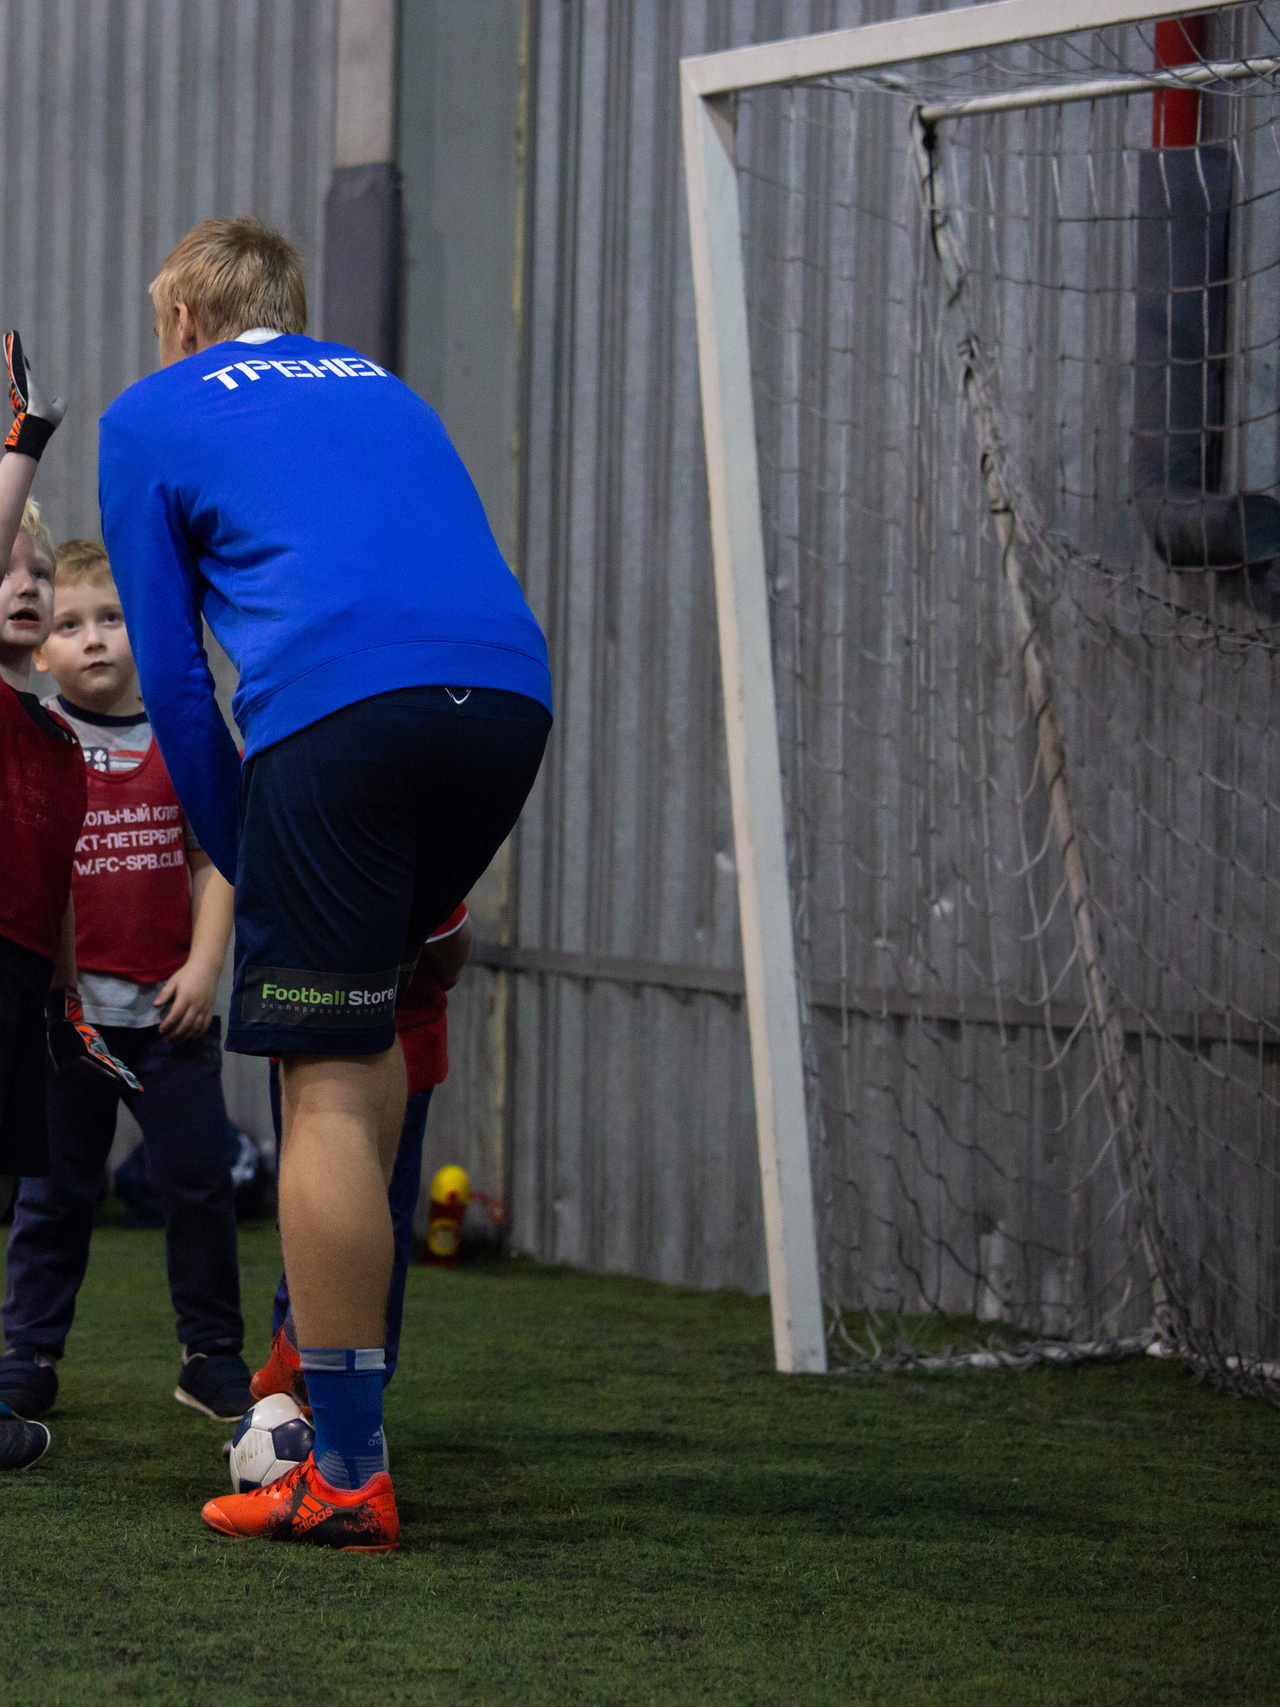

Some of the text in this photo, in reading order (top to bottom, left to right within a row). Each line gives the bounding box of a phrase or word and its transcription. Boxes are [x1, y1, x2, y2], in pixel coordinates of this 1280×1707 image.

[82, 803, 151, 827] ОЛЬНЫЙ
[73, 850, 184, 877] W.FC-SPB.CLUB
[261, 983, 397, 1006] Football Store
[291, 1506, 334, 1536] adidas
